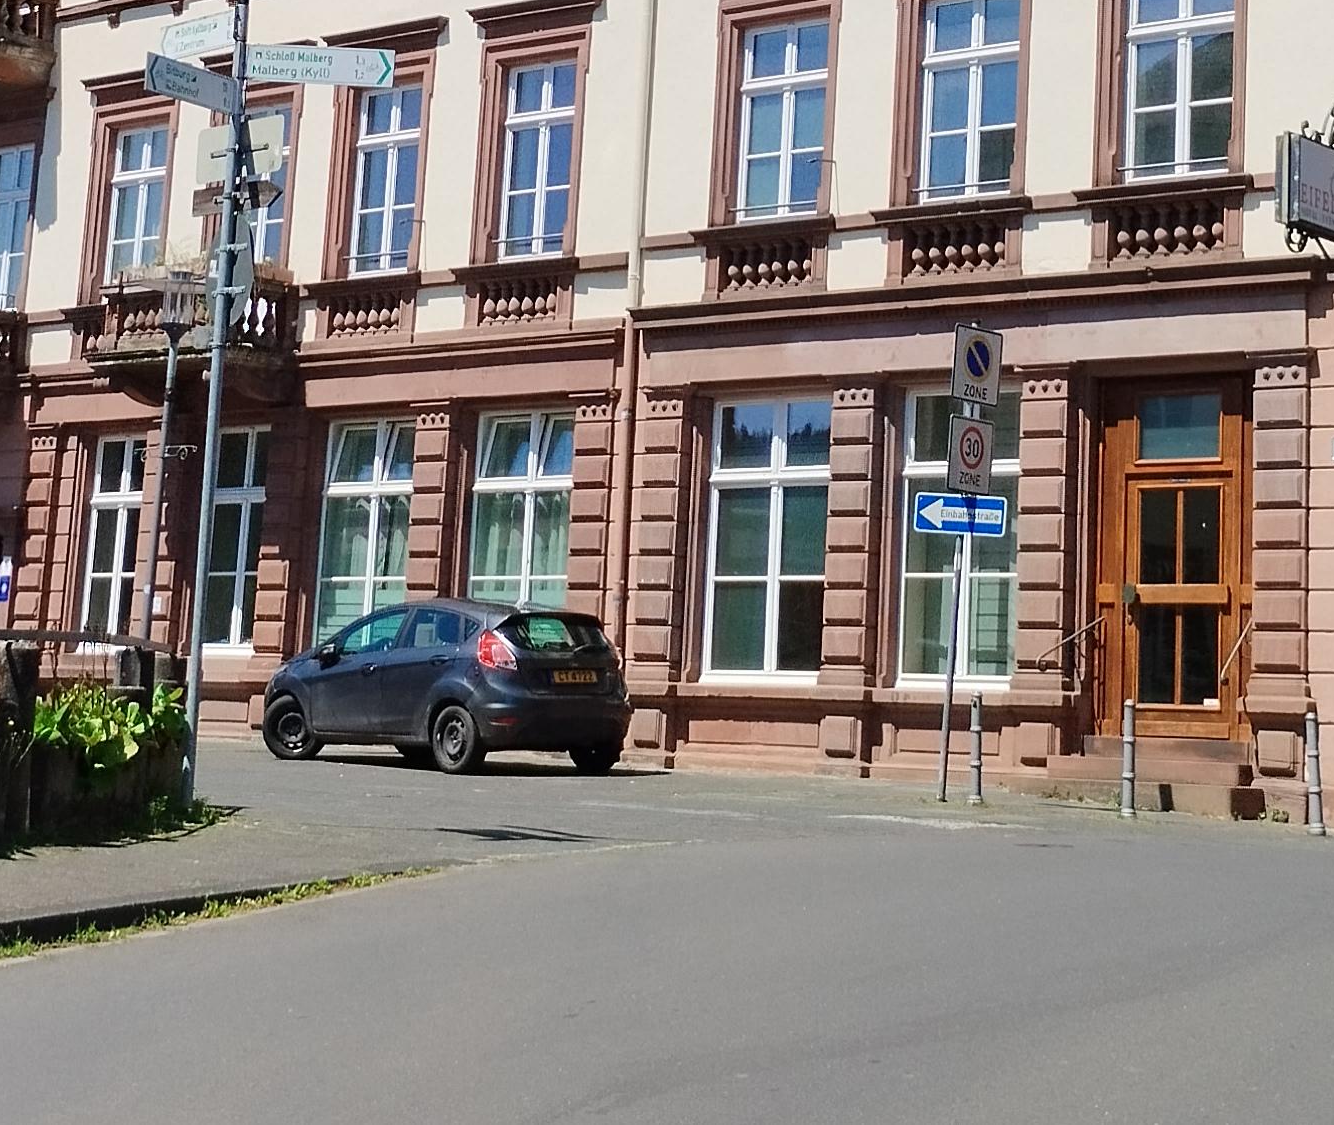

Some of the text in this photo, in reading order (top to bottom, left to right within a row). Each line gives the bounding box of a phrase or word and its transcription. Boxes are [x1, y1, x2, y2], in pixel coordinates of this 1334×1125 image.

[297, 52, 333, 65] Malberg
[252, 65, 298, 79] Malberg
[301, 67, 331, 79] (Kyll)
[963, 383, 988, 401] ZONE
[964, 437, 980, 458] 30
[959, 471, 981, 487] ZONE
